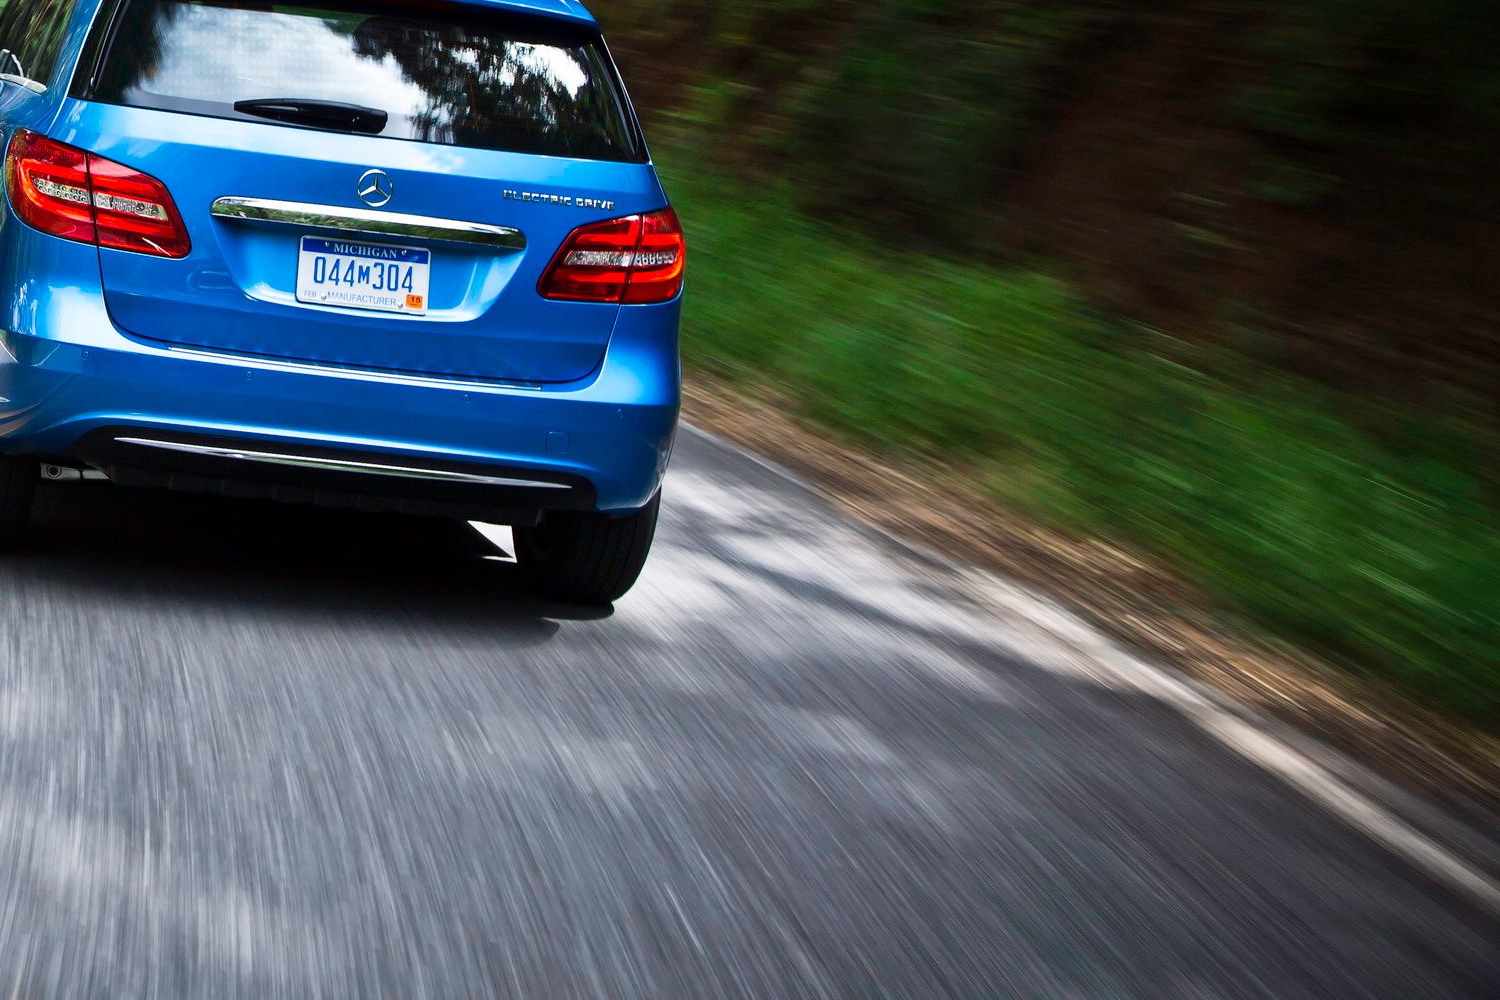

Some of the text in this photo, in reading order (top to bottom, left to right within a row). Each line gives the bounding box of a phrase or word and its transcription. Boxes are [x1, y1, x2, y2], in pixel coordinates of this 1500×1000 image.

[333, 243, 397, 259] MICHIGAN
[313, 256, 414, 293] 044M304
[304, 289, 397, 306] FEB MANUFACTURER
